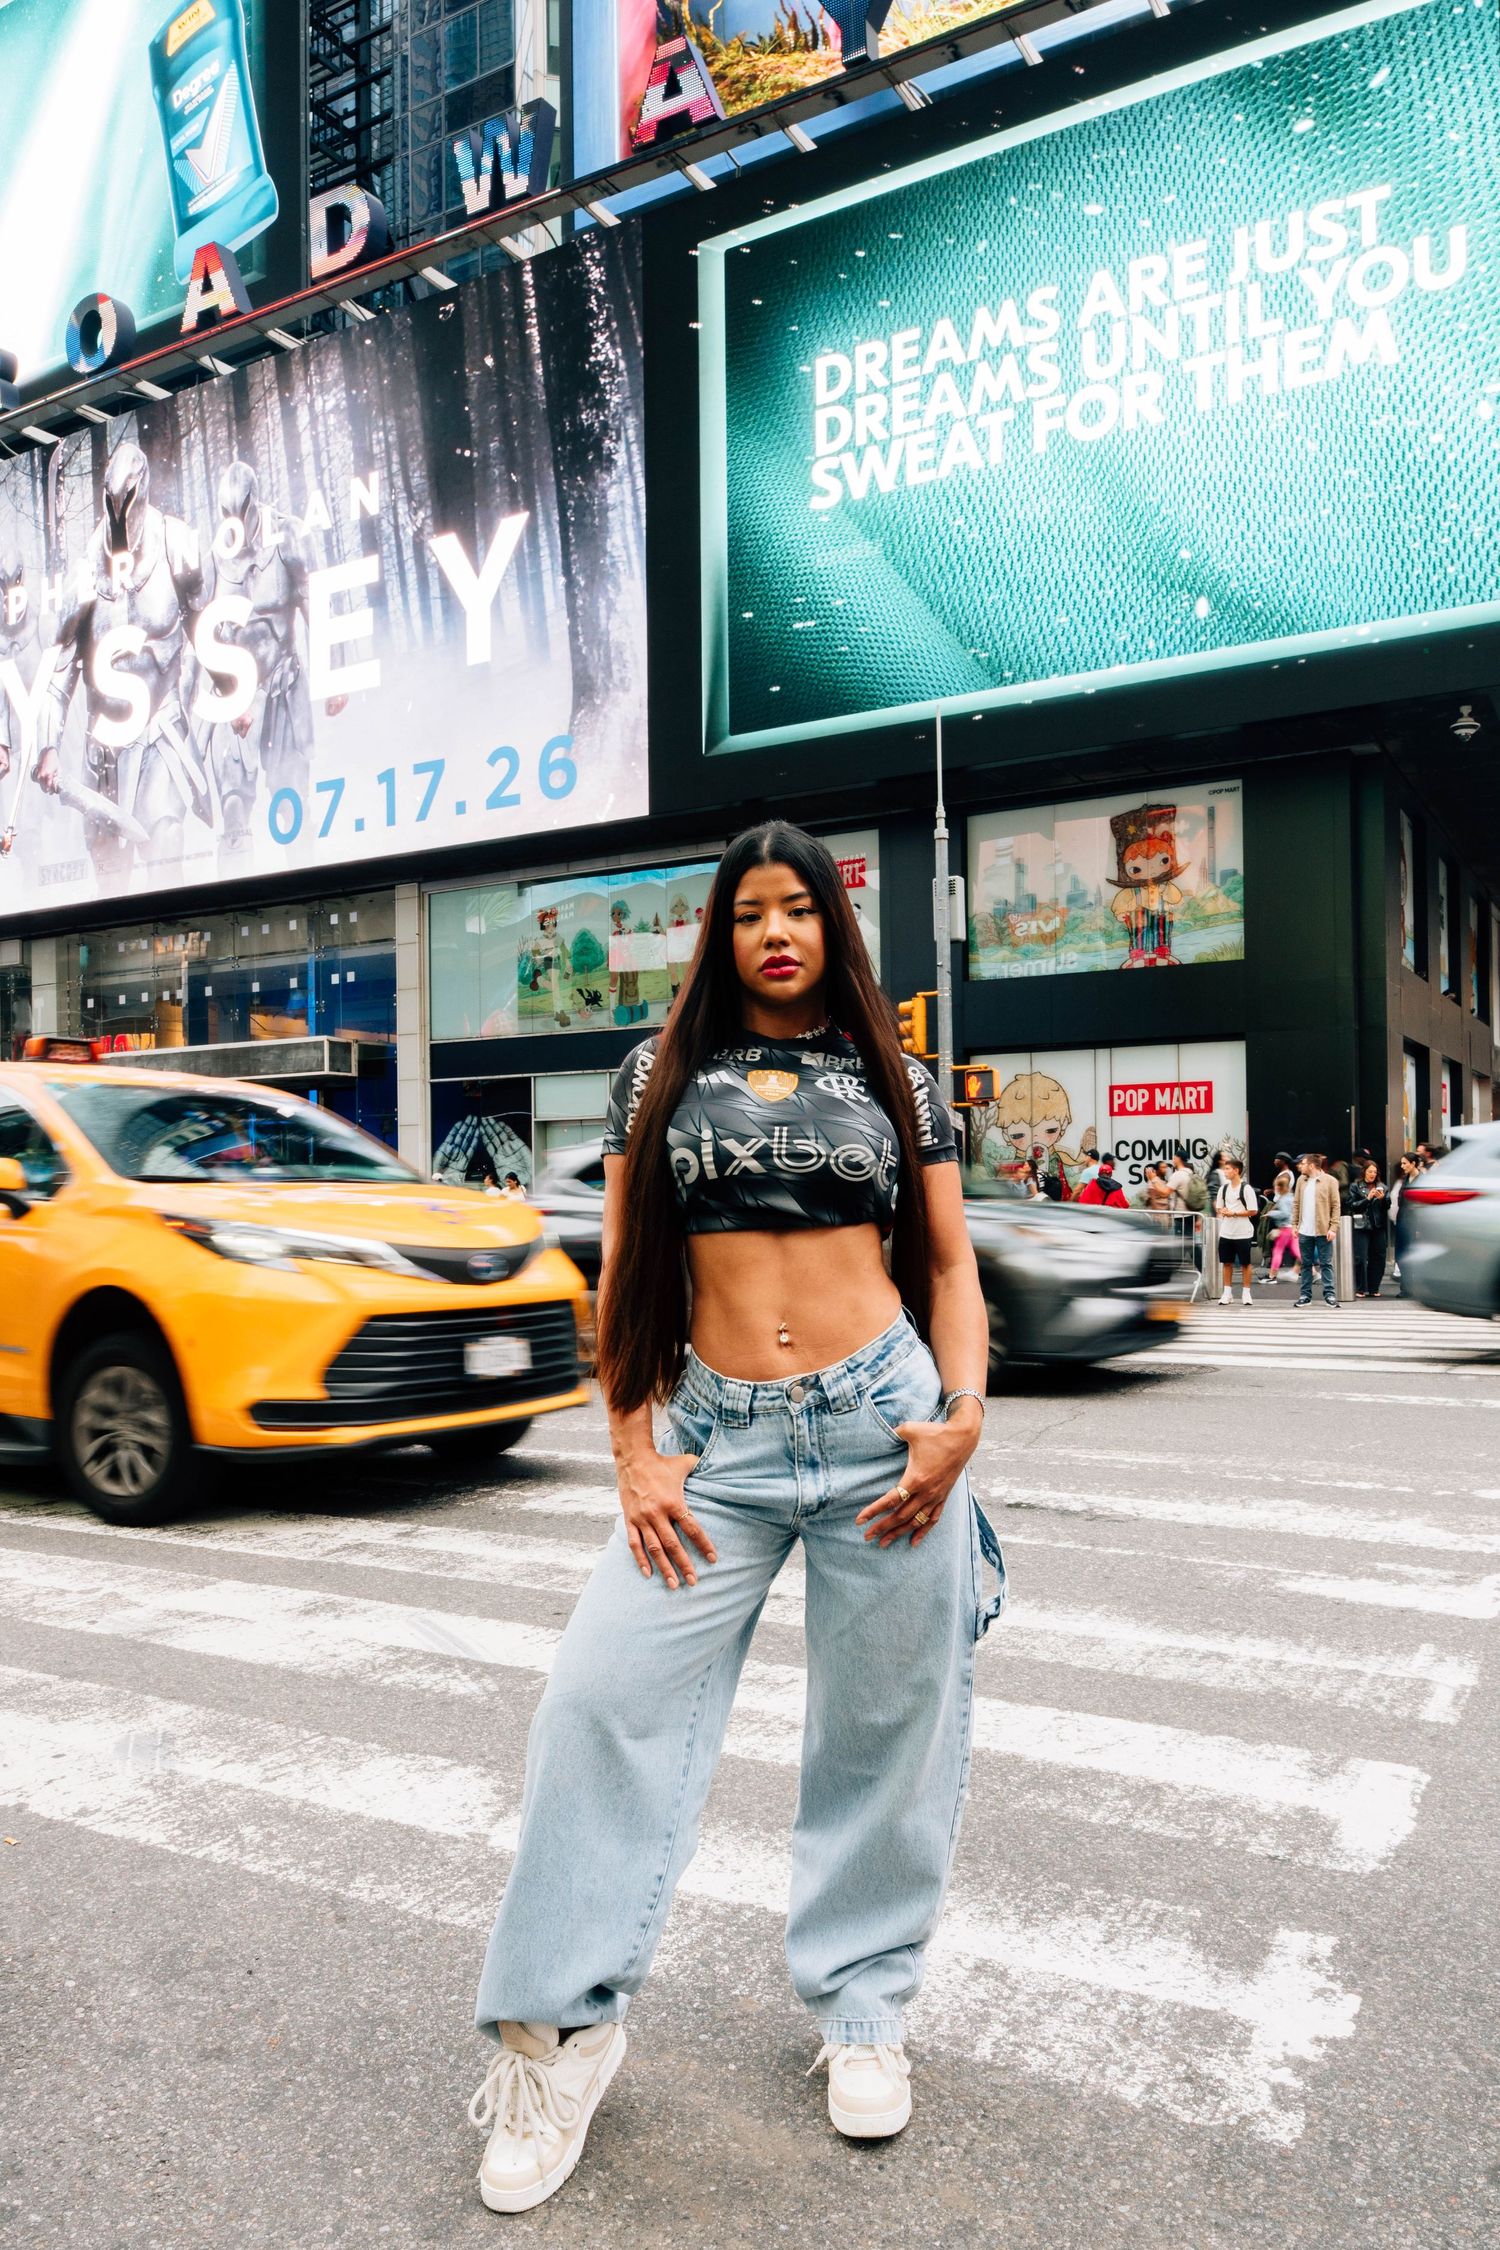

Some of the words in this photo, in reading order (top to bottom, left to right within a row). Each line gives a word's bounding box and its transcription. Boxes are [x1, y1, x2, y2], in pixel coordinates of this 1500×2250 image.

[814, 286, 1061, 406] DREAMS
[1076, 238, 1210, 329] ARE
[1229, 184, 1391, 286] JUST
[814, 341, 1061, 458] DREAMS
[1081, 281, 1285, 382] UNTIL
[1296, 224, 1468, 321] YOU
[809, 408, 1016, 510] SWEAT
[1031, 367, 1167, 454] FOR
[1181, 307, 1403, 413] THEM
[173, 471, 380, 576] NOLAN
[0, 511, 530, 760] YSSEY
[267, 735, 577, 846] 07.17.26
[1113, 1088, 1149, 1112] POP
[1154, 1086, 1208, 1111] MART
[1115, 1138, 1209, 1161] COMING
[670, 1126, 898, 1202] pixbet
